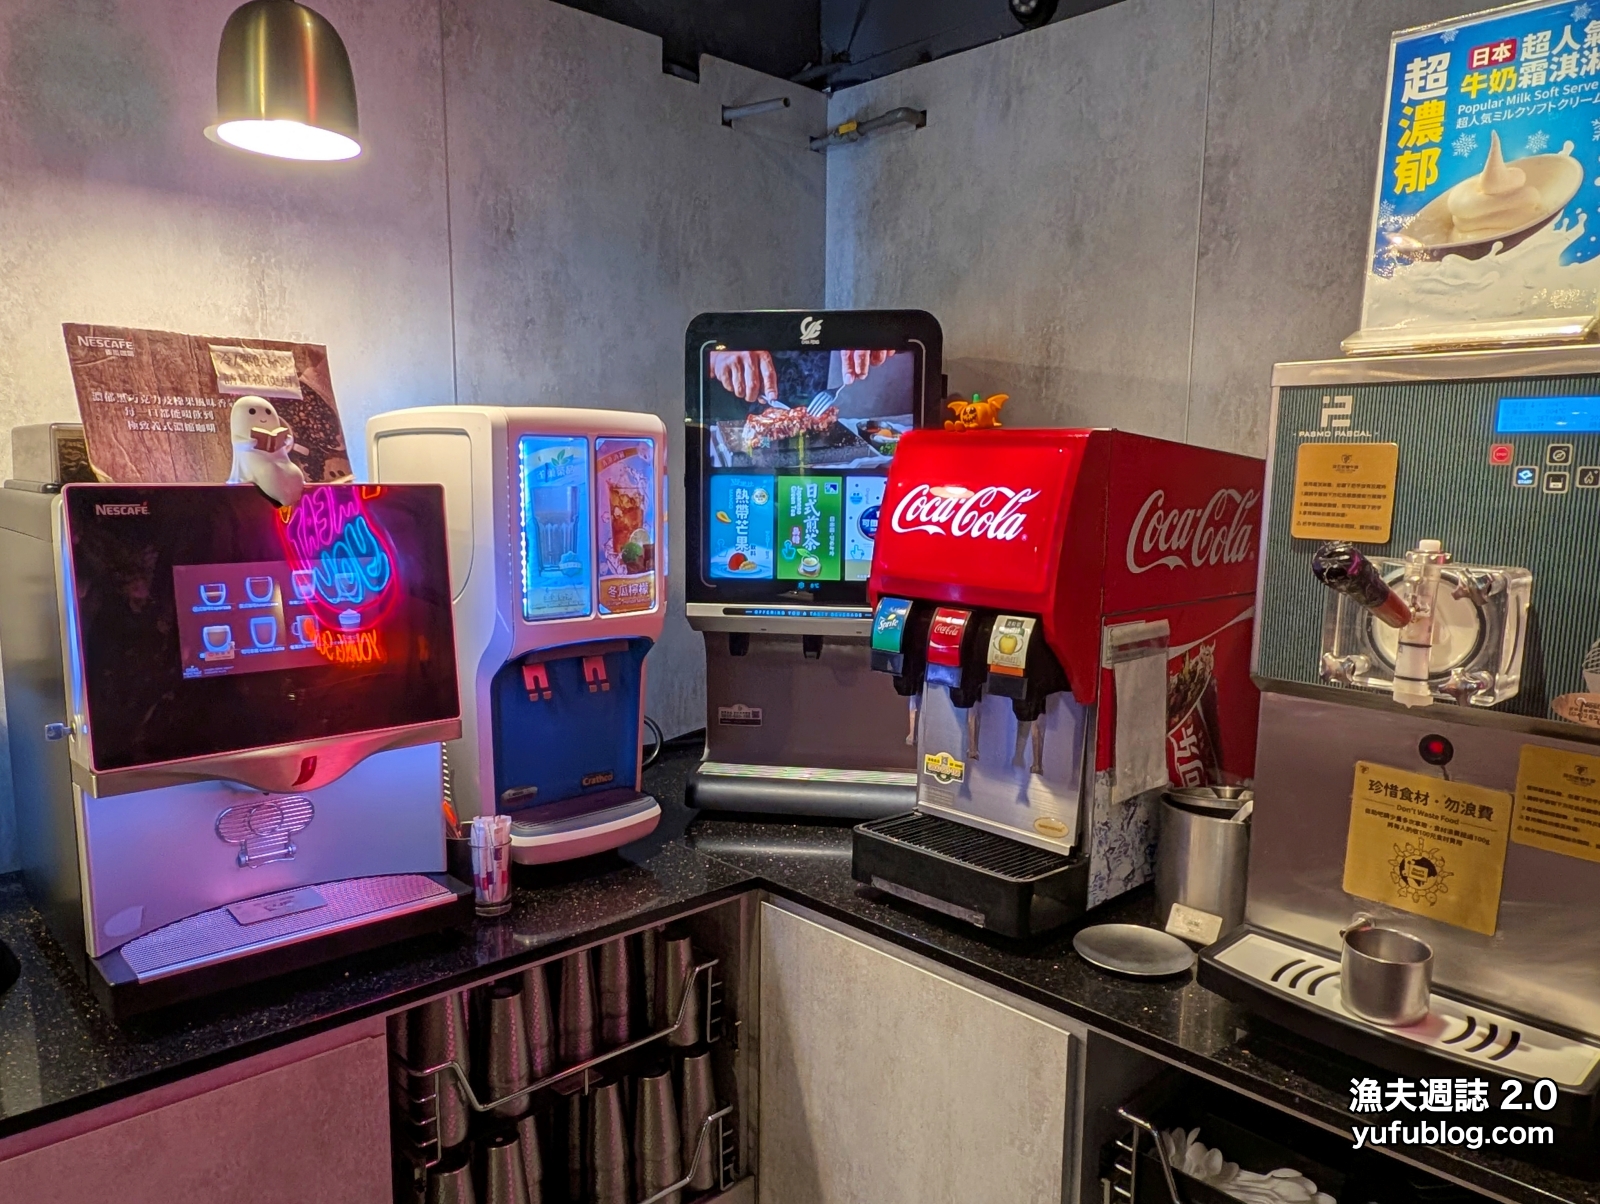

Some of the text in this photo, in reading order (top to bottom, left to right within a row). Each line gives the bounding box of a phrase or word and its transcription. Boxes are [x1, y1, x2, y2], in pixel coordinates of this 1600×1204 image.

[1472, 42, 1512, 68] 日本
[1457, 80, 1599, 115] Popular Milk Soft Serve
[1394, 52, 1451, 195] 超濃郁
[1299, 430, 1373, 438] PASMO PASCAL
[735, 488, 750, 552] 熱帶芒果
[802, 483, 821, 551] 日式煎茶
[891, 484, 1042, 541] Coca-Cola
[1126, 488, 1260, 574] Coca-Cola
[608, 582, 648, 598] 冬瓜檸檬
[878, 619, 899, 632] Sprite
[1396, 804, 1460, 825] Don't Waste Food
